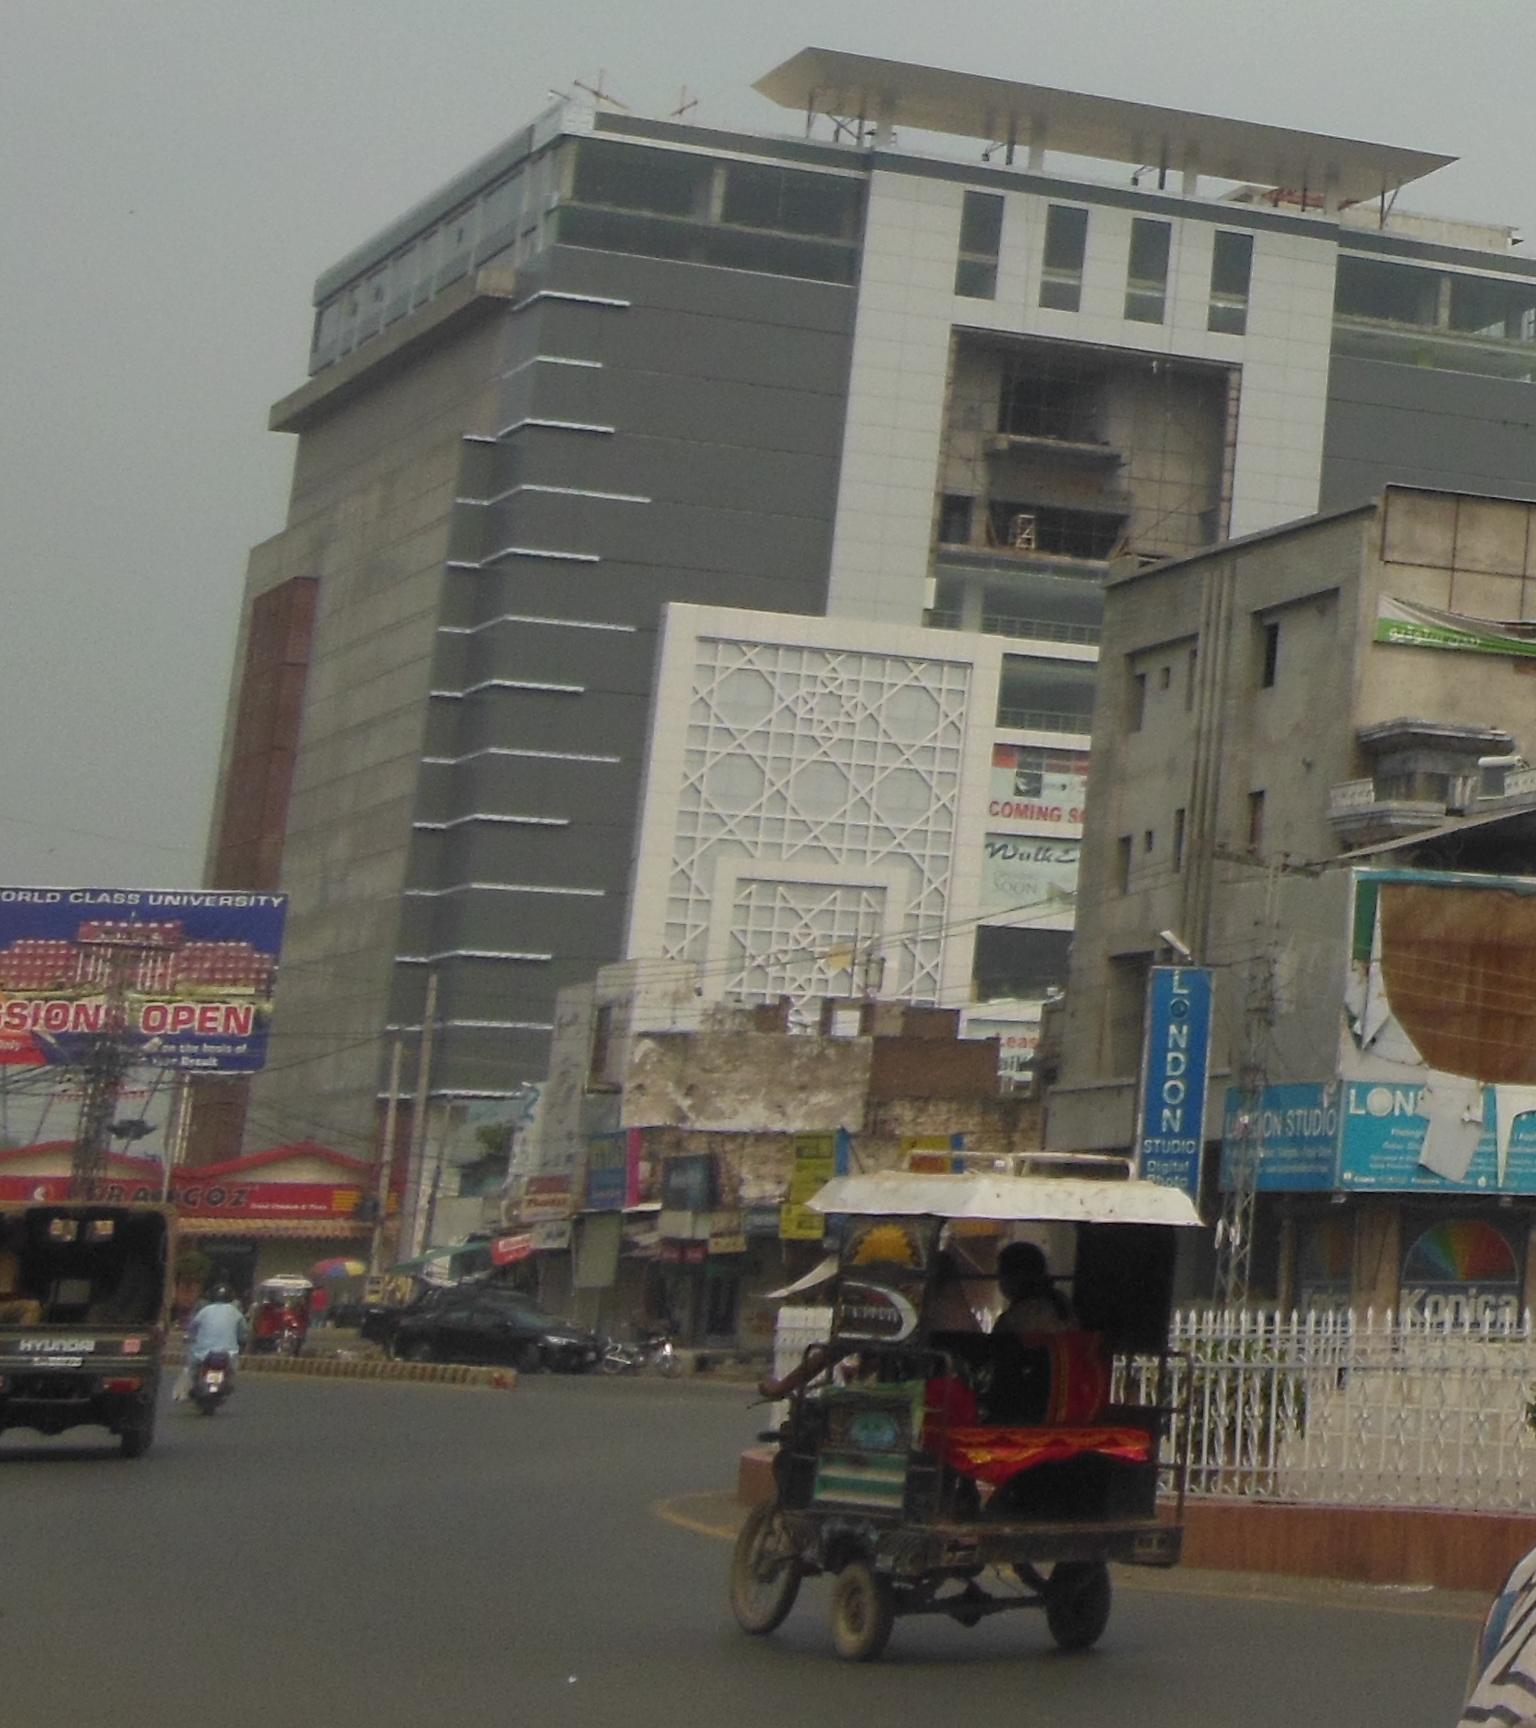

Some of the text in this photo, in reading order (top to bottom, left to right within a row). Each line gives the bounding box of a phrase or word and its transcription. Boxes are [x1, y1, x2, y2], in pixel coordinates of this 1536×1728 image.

[988, 800, 1063, 822] COMING
[68, 891, 141, 906] CLASS
[148, 893, 284, 908] UNIVERSITY
[0, 999, 254, 1037] SION OPEN
[1161, 970, 1191, 1133] LONDON
[1349, 1087, 1425, 1118] LON
[1287, 1108, 1338, 1139] STUDIO
[1143, 1139, 1197, 1155] STUDIO
[1400, 1287, 1519, 1331] Konica
[19, 1338, 96, 1353] HYUNDAI
